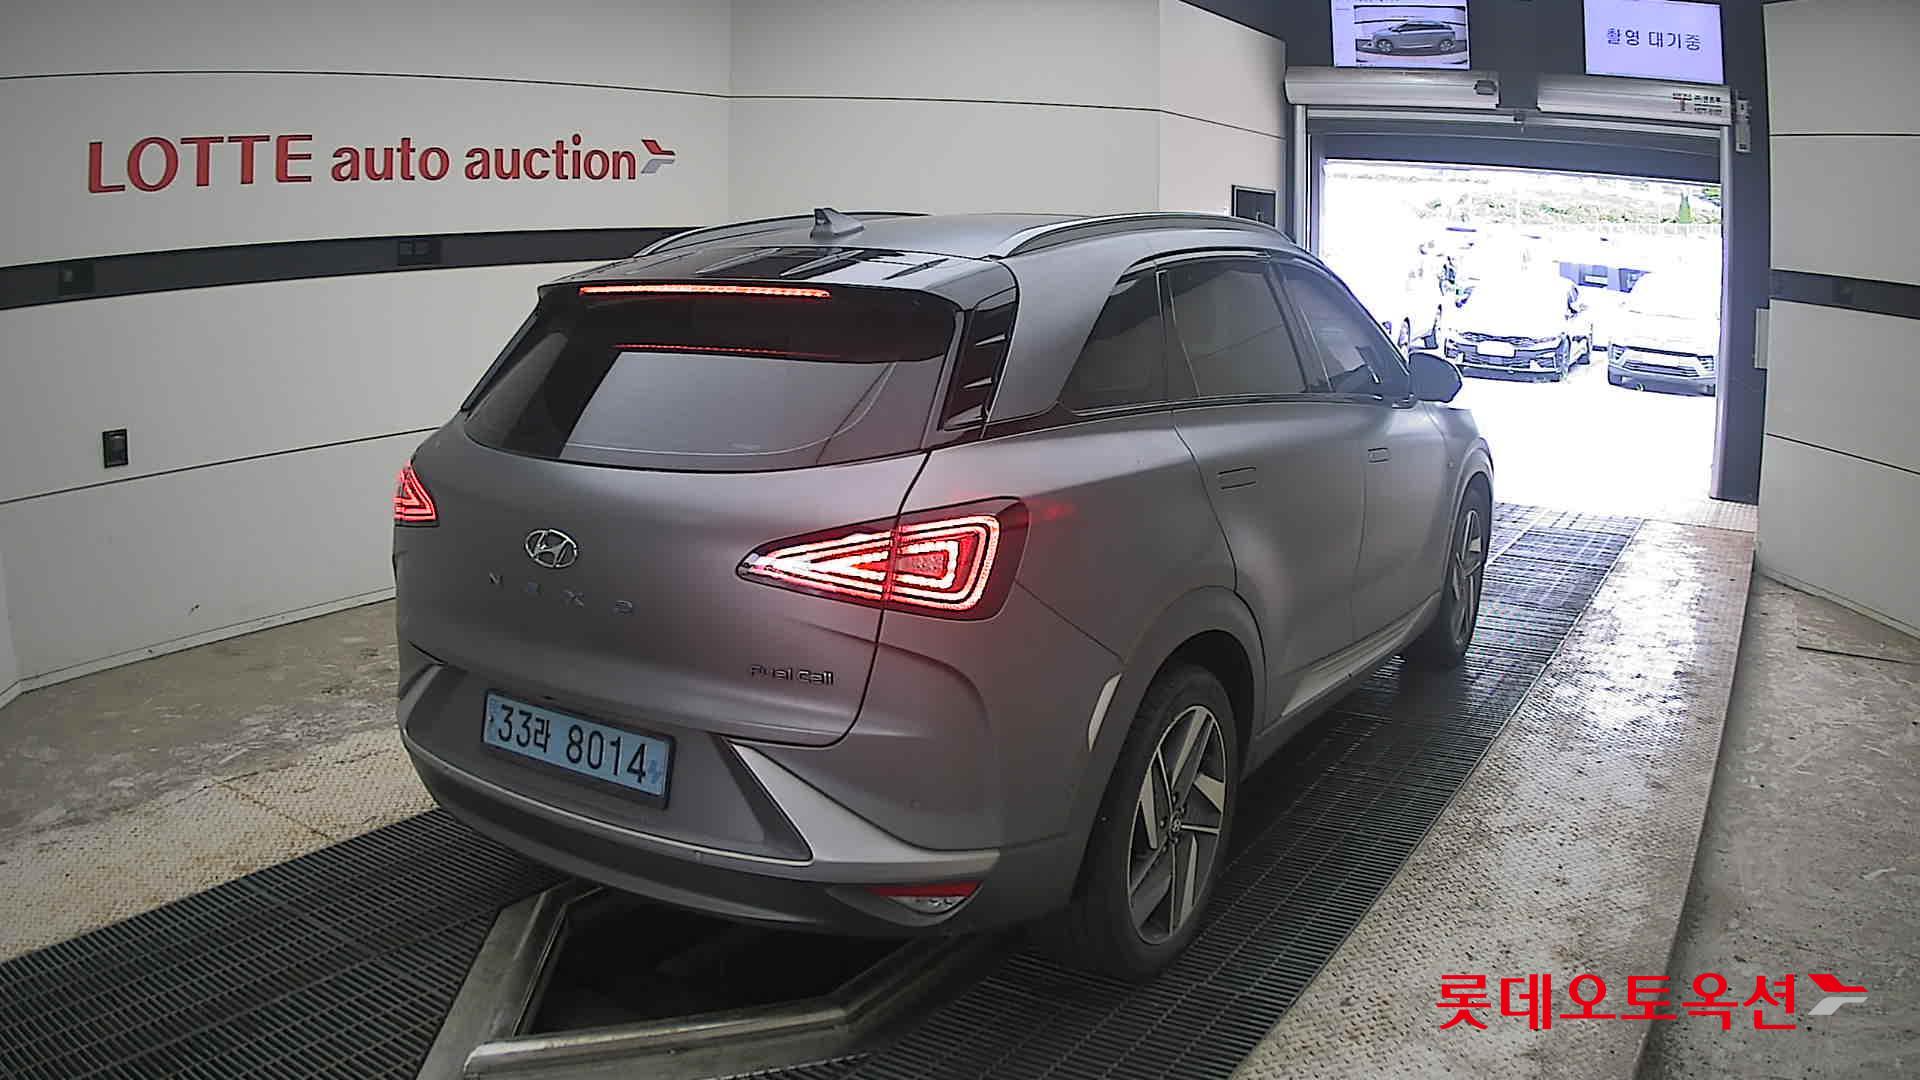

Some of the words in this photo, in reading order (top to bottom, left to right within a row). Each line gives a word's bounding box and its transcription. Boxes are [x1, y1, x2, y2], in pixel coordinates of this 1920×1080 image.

[1607, 27, 1640, 46] 촬영
[1648, 31, 1701, 51] 대기중
[88, 134, 313, 193] LOTTE
[330, 138, 451, 182] auto
[464, 134, 637, 182] auction
[498, 704, 552, 753] 33라
[566, 724, 647, 784] 8014
